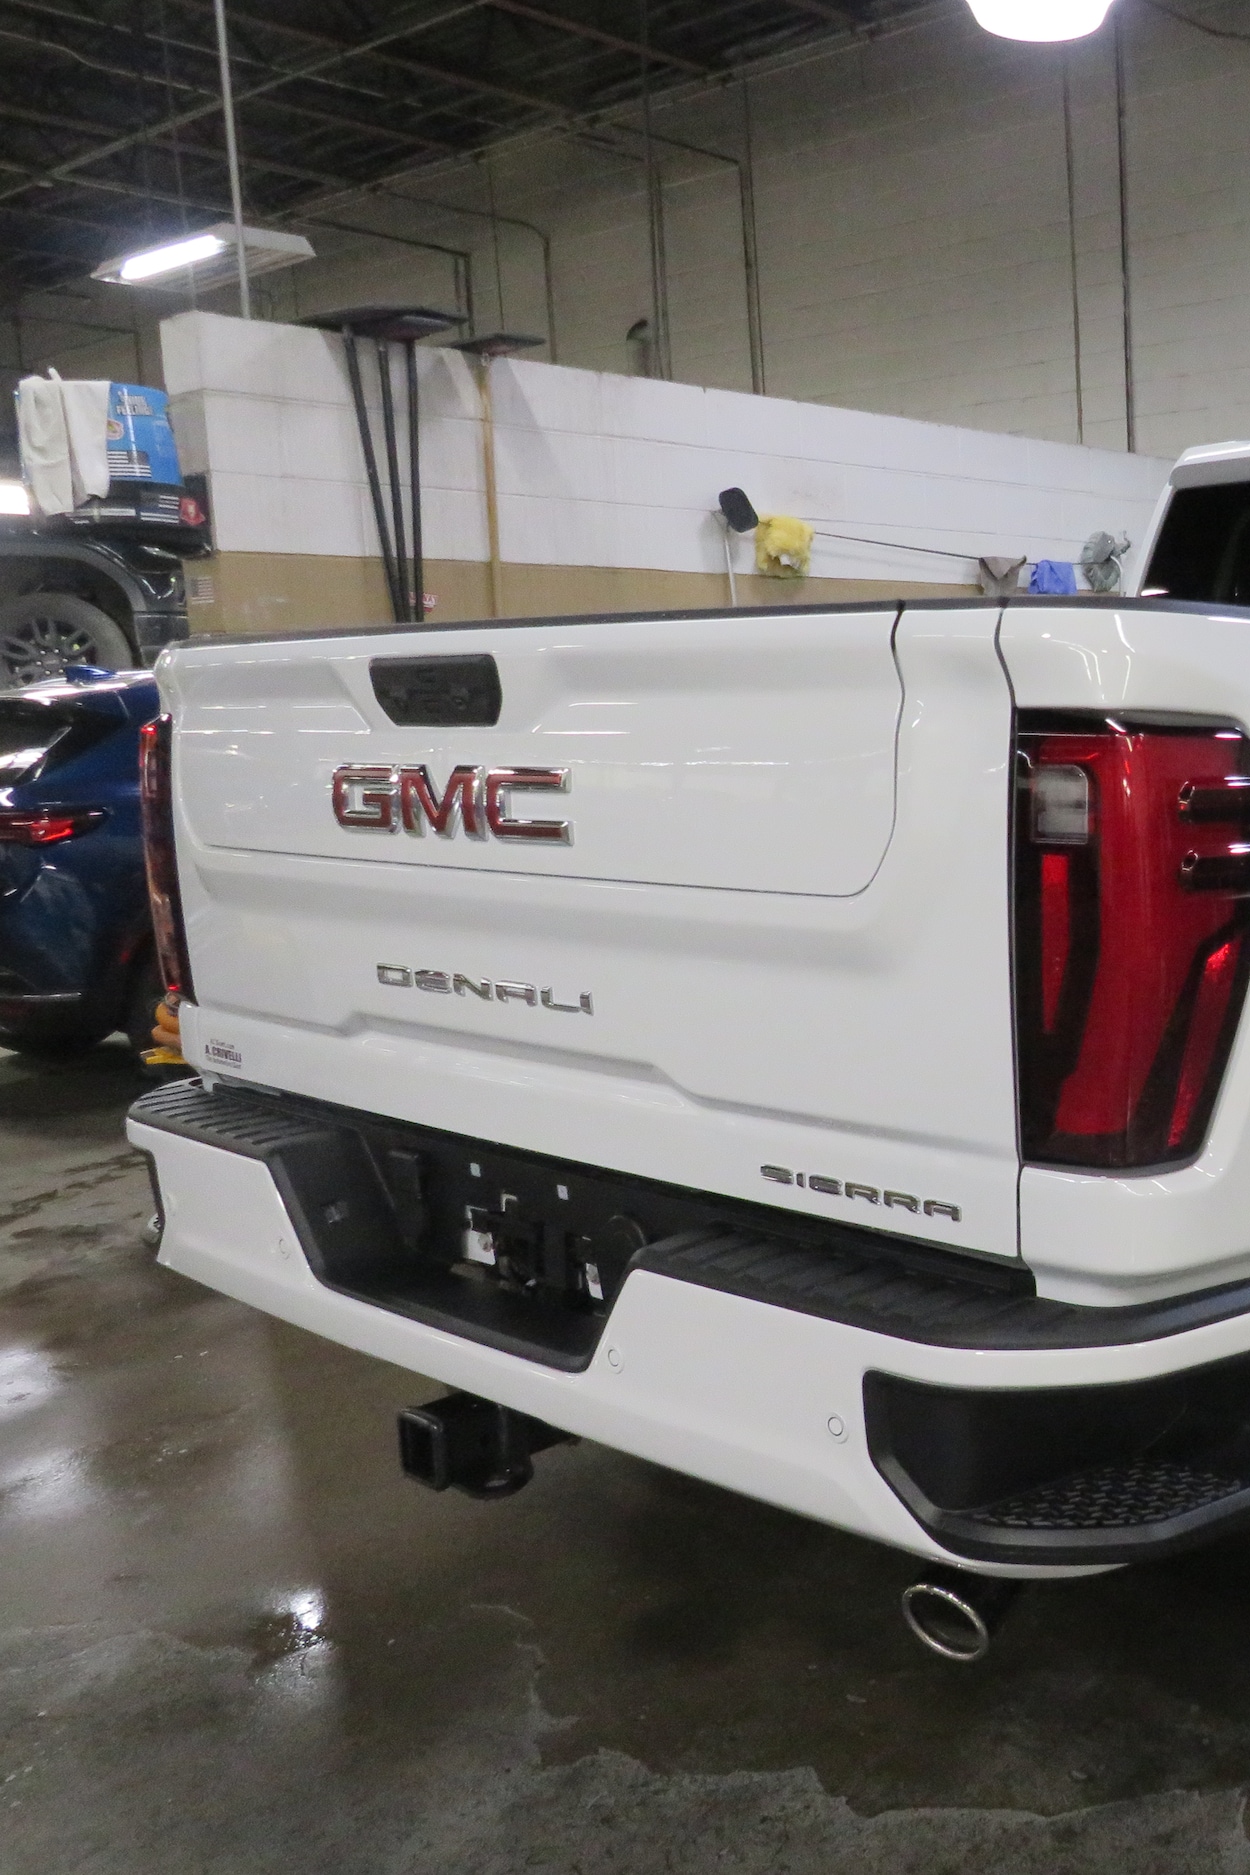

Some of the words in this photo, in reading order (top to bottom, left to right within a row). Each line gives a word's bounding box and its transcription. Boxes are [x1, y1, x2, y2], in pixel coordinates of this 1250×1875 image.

[332, 762, 575, 847] GMC
[376, 962, 594, 1016] DENALI
[760, 1163, 963, 1223] SIERRA
